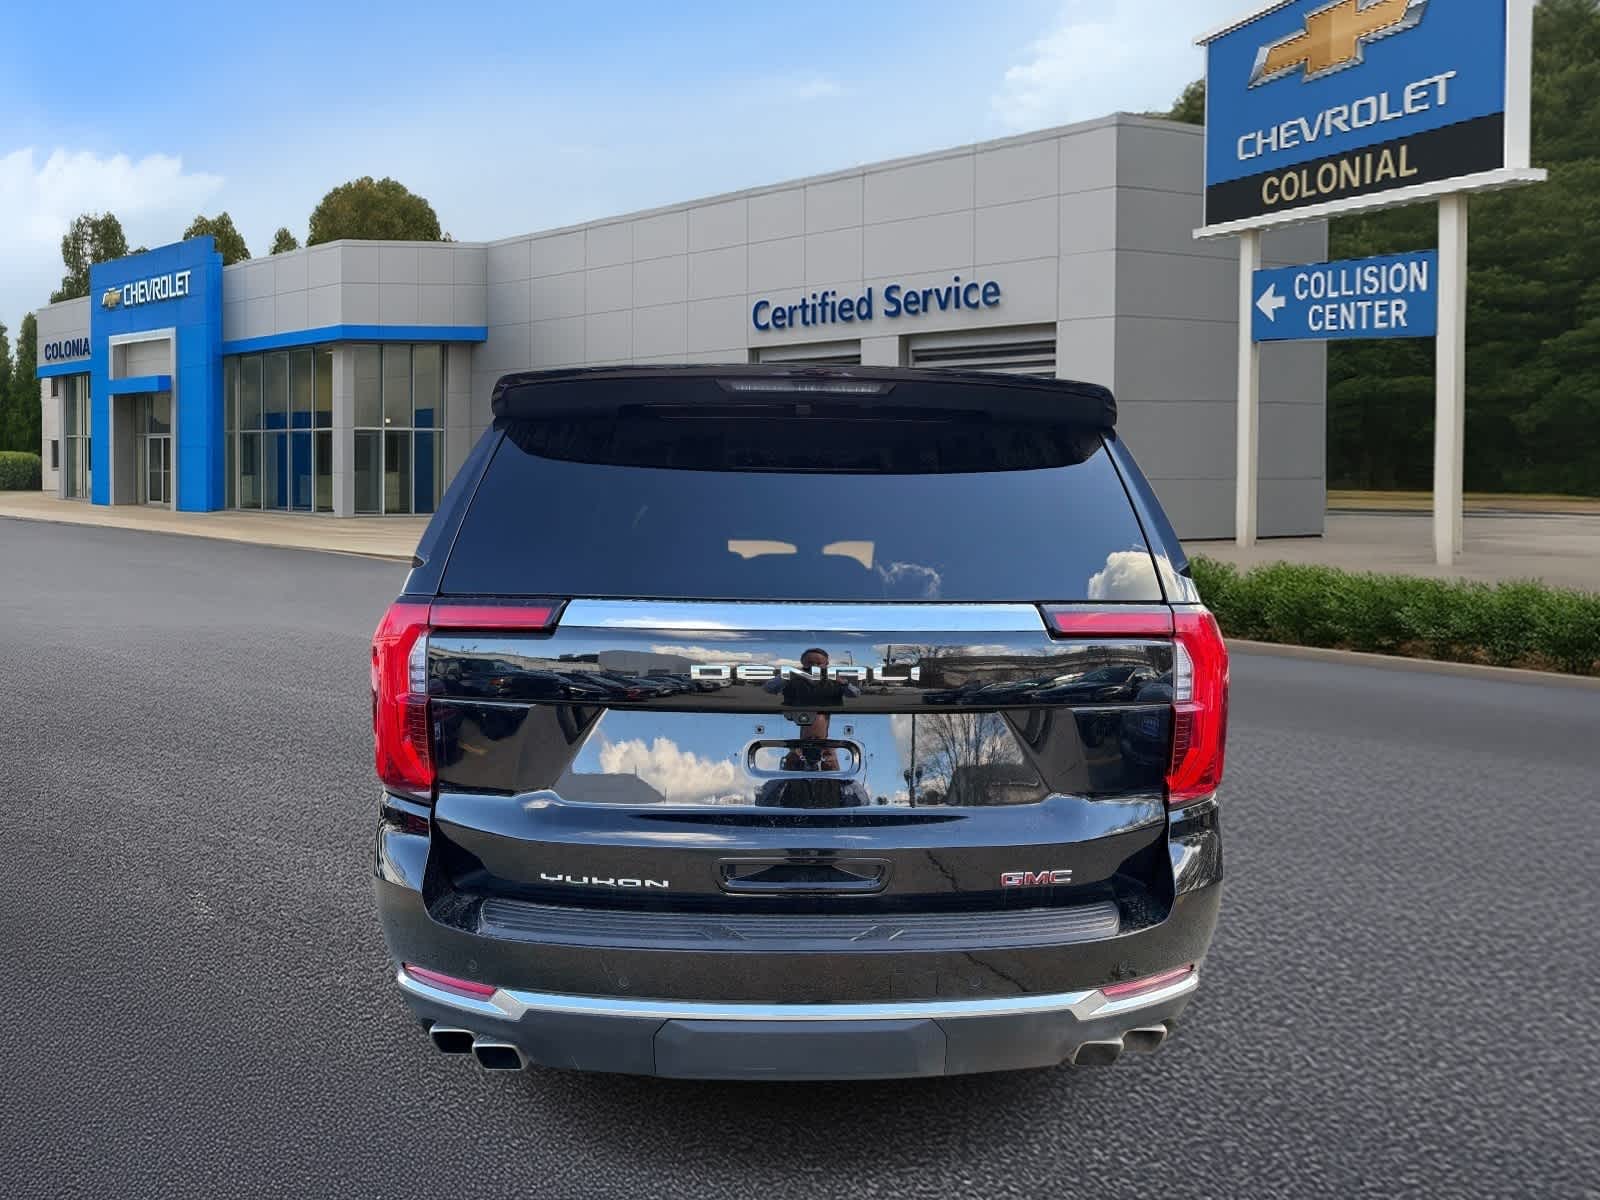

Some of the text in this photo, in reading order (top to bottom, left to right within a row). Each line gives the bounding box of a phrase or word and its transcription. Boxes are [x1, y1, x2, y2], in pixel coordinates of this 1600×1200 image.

[1236, 70, 1457, 160] CHEVROLET
[1261, 144, 1418, 205] COLONIAL
[123, 270, 191, 306] CHEVROLET
[1294, 260, 1428, 300] COLLISION
[752, 276, 1001, 331] Certified Service
[1307, 300, 1408, 332] CENTER
[690, 663, 920, 682] DENALI
[540, 872, 669, 888] YUKON
[1000, 869, 1073, 887] GMC
